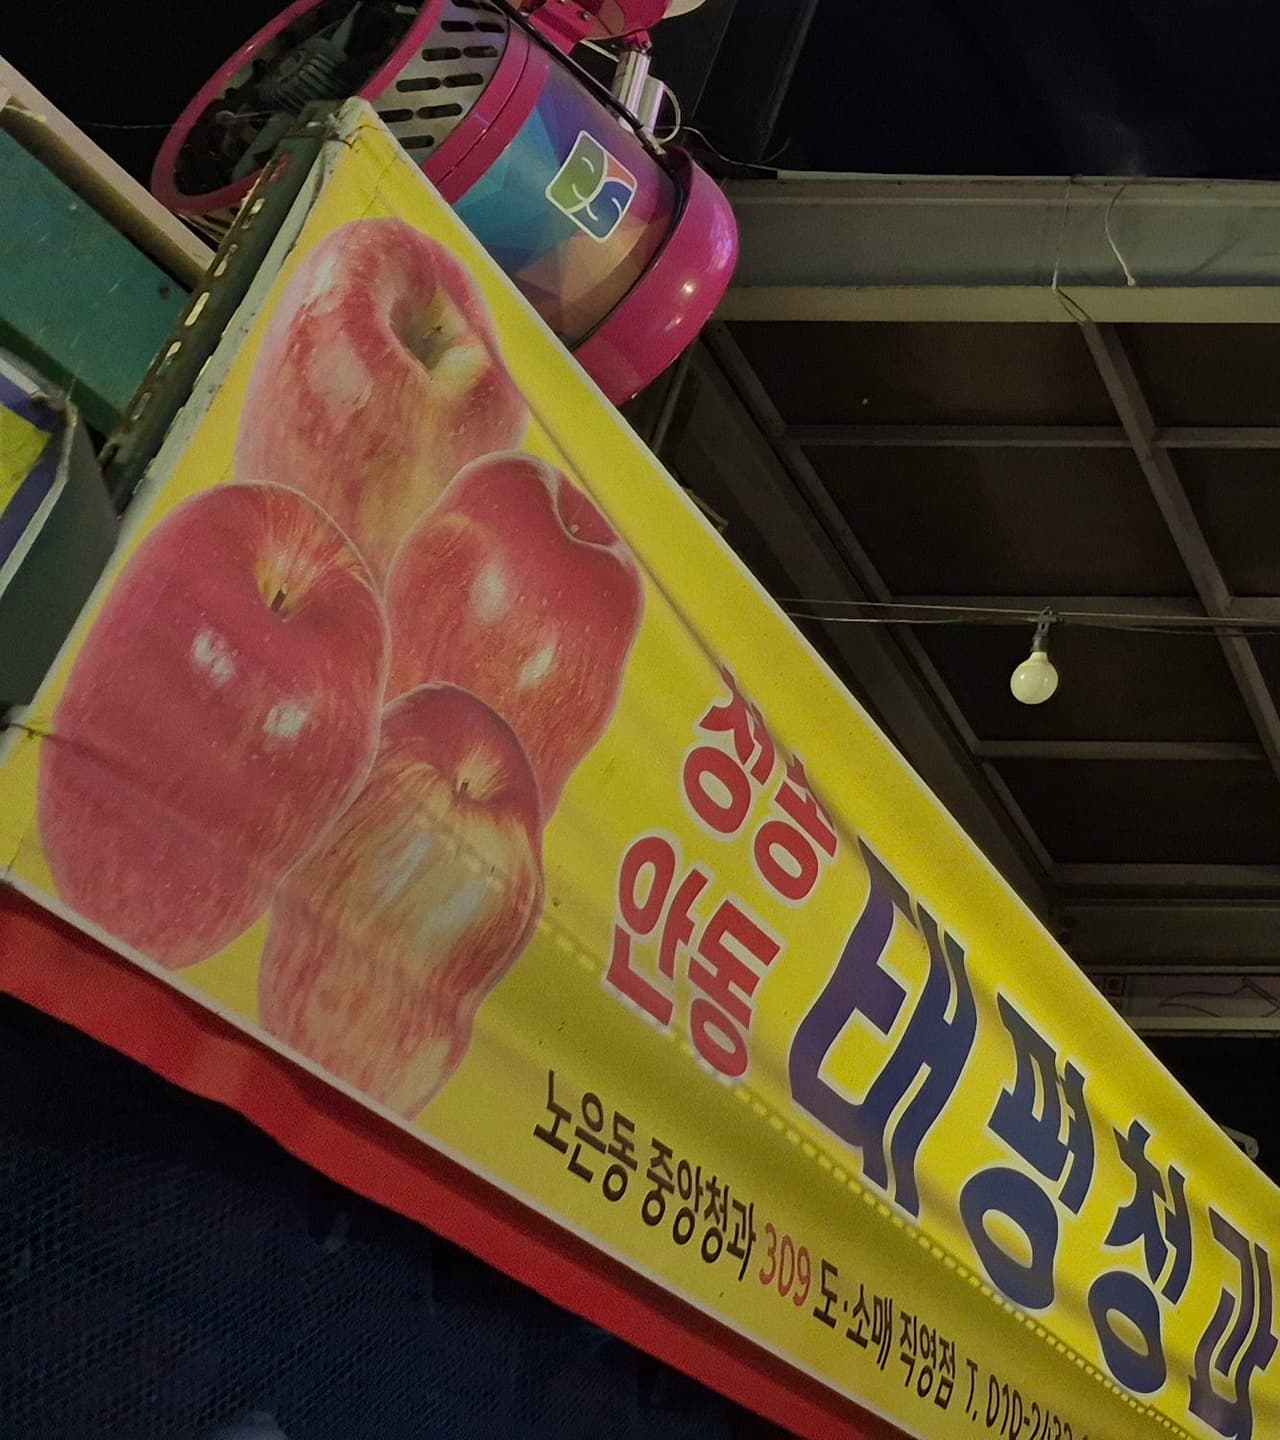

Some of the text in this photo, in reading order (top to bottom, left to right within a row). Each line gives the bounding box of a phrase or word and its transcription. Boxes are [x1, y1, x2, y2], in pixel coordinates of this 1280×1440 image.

[604, 836, 782, 1078] 안동
[533, 1070, 638, 1202] 노은동
[641, 1136, 757, 1282] 중앙청과
[759, 1222, 812, 1308] 309
[899, 1311, 957, 1410] 직영점
[788, 834, 1280, 1440] 태평청과
